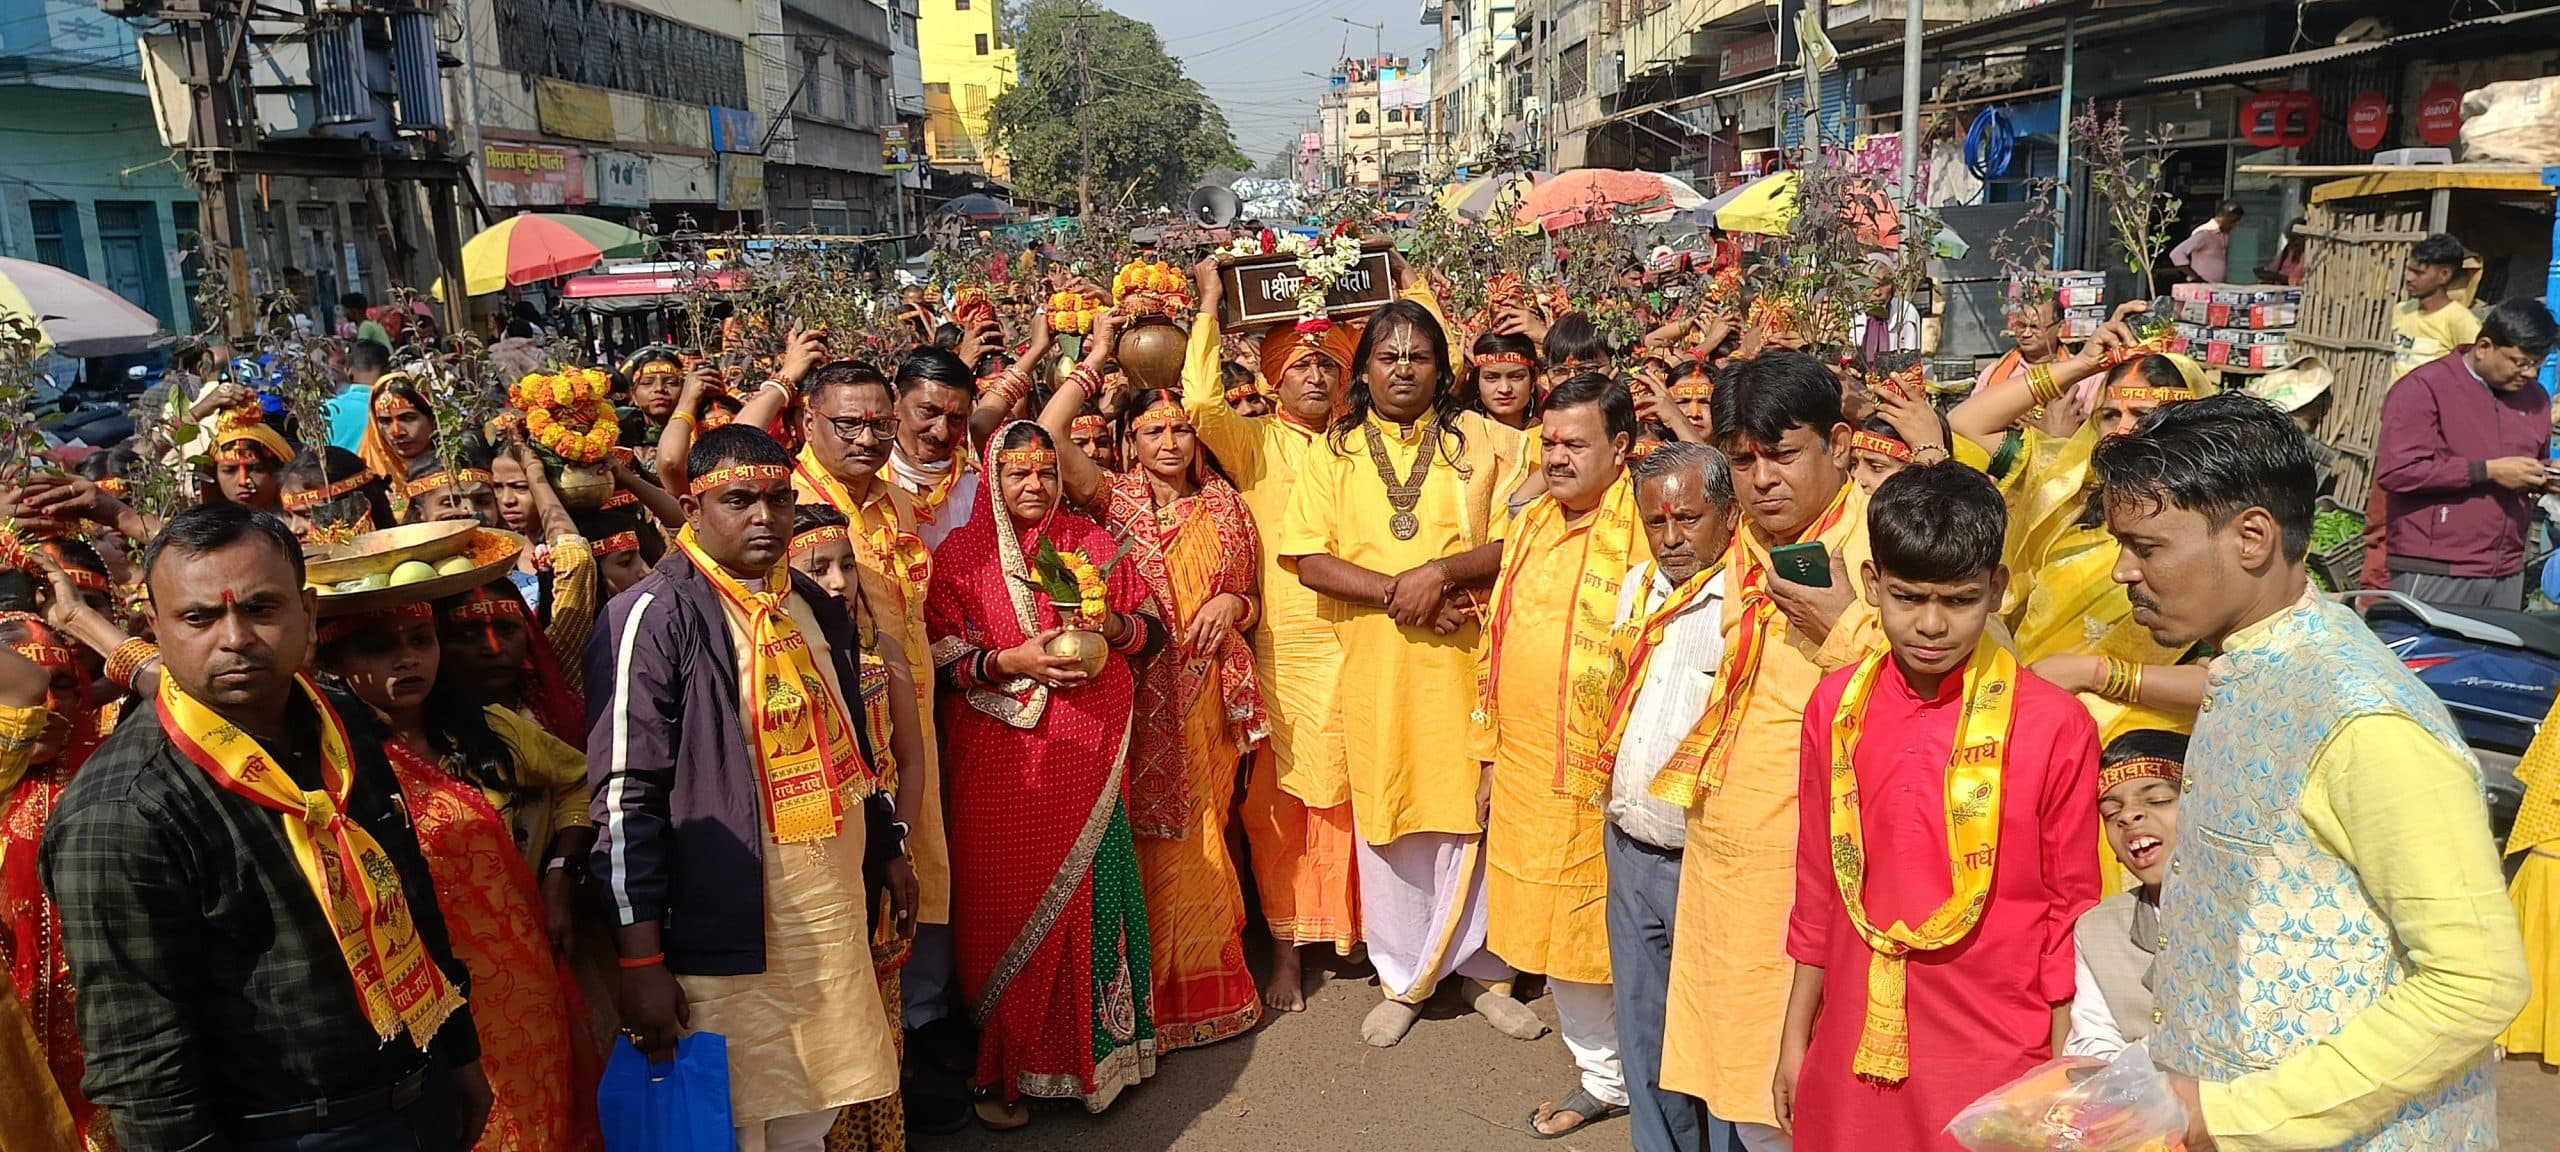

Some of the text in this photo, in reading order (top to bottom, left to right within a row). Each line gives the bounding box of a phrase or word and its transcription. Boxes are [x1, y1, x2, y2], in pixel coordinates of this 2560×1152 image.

[2121, 387, 2147, 400] जय
[2151, 386, 2169, 401] श्री
[1866, 436, 1894, 455] राम
[707, 464, 784, 487] जय श्री राम
[793, 532, 817, 549] जय
[821, 526, 838, 542] श्री
[17, 642, 46, 662] श्री
[1964, 736, 1999, 765] राधे
[240, 754, 272, 783] राधे
[774, 774, 821, 799] राधे-राधे
[1964, 843, 1995, 871] राधे
